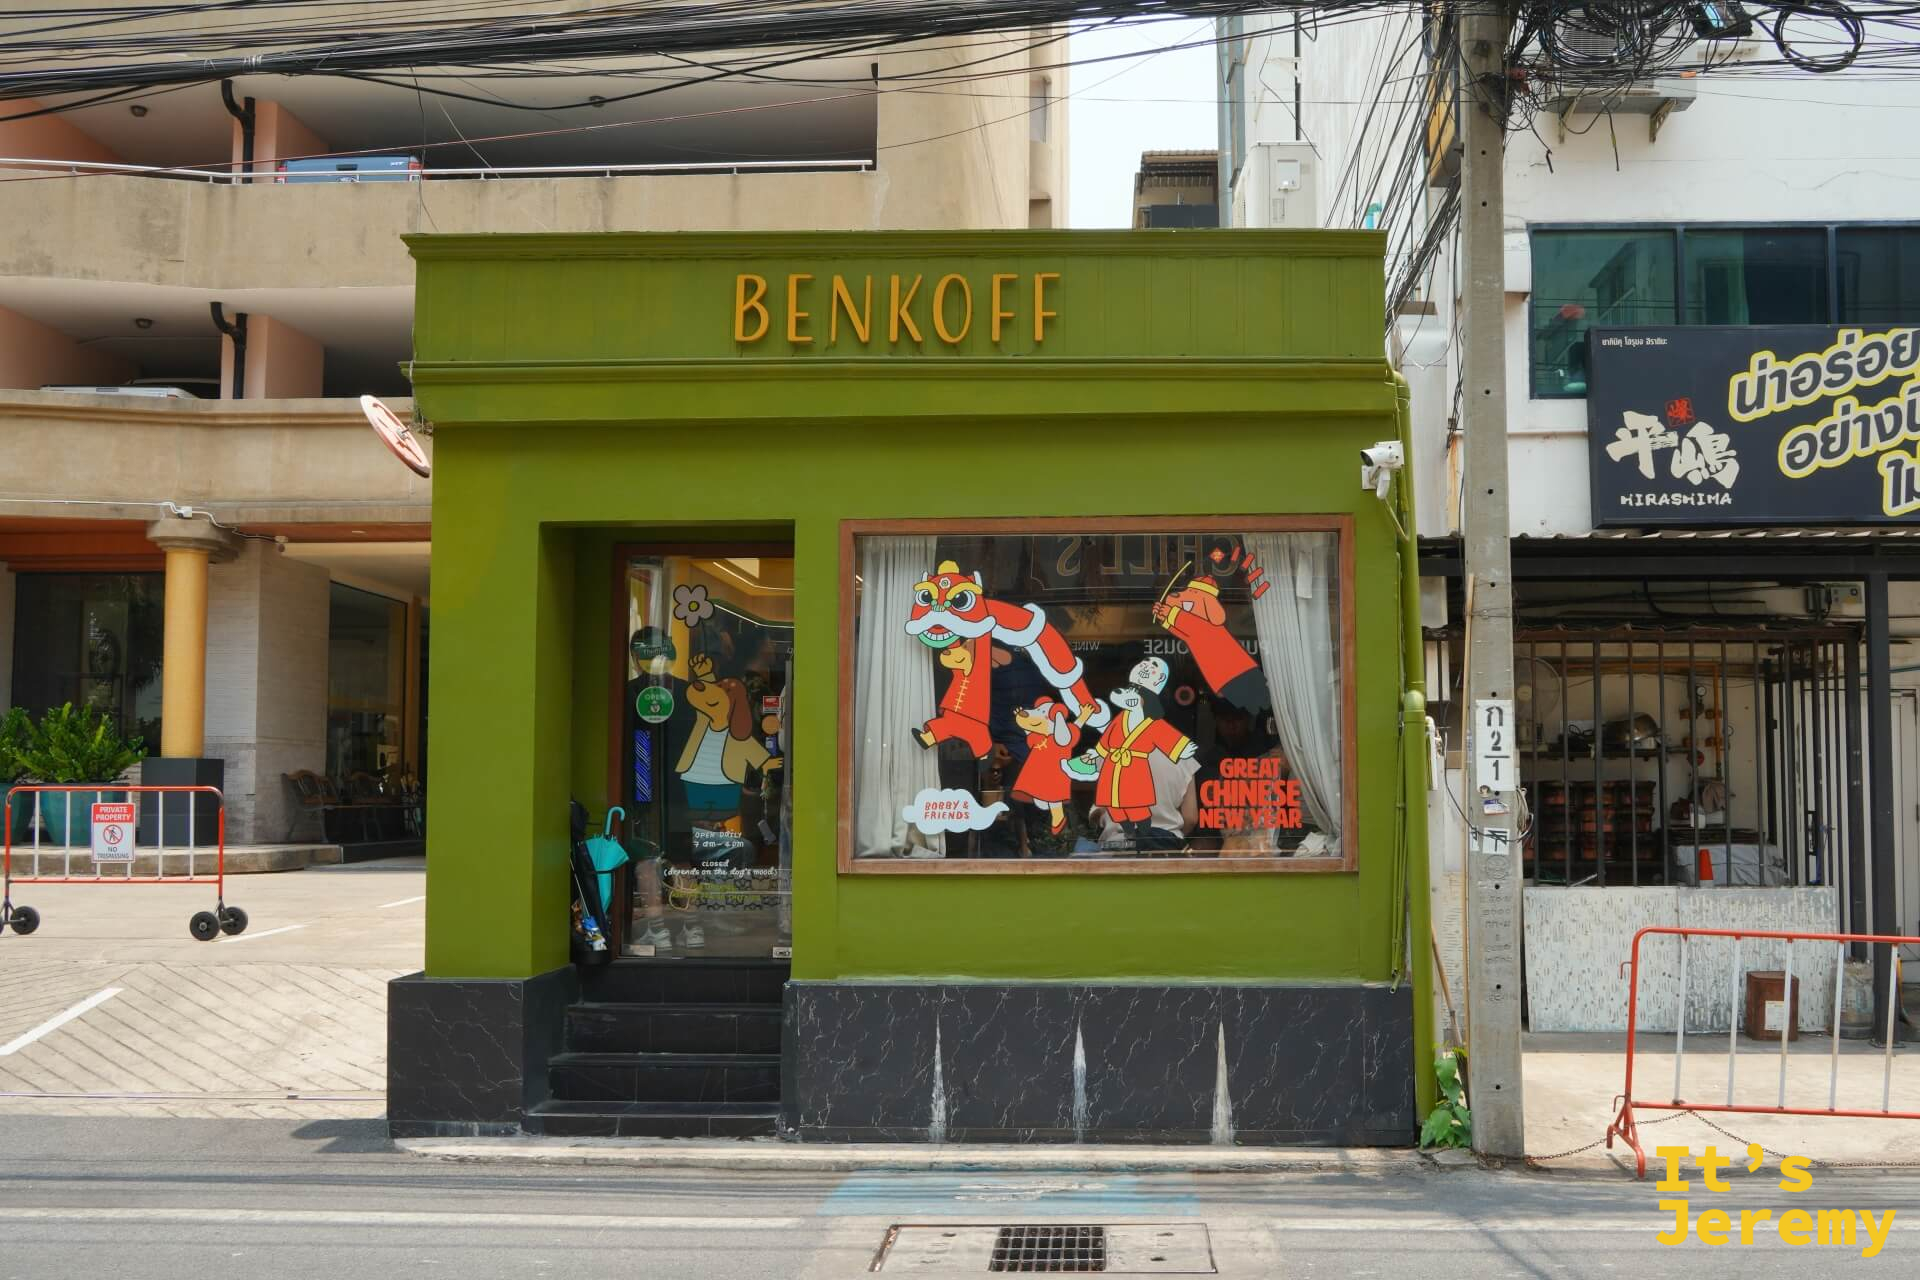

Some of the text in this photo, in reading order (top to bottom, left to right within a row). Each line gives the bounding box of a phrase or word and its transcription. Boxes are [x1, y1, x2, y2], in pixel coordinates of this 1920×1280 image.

[735, 272, 1061, 343] BENKOFF
[1621, 493, 1732, 506] HIRASHIMA
[1486, 706, 1504, 726] ก
[1491, 731, 1502, 751] 2
[1219, 758, 1280, 779] GREAT
[1492, 760, 1500, 781] 1
[1200, 780, 1301, 807] CHINESE
[924, 811, 970, 820] FRIENDS
[925, 800, 969, 811] BOBBY &
[1200, 808, 1302, 830] NEW YEAR
[695, 831, 715, 839] OPEN
[664, 866, 700, 877] (depends
[713, 867, 727, 876] the
[753, 866, 778, 877] mood)
